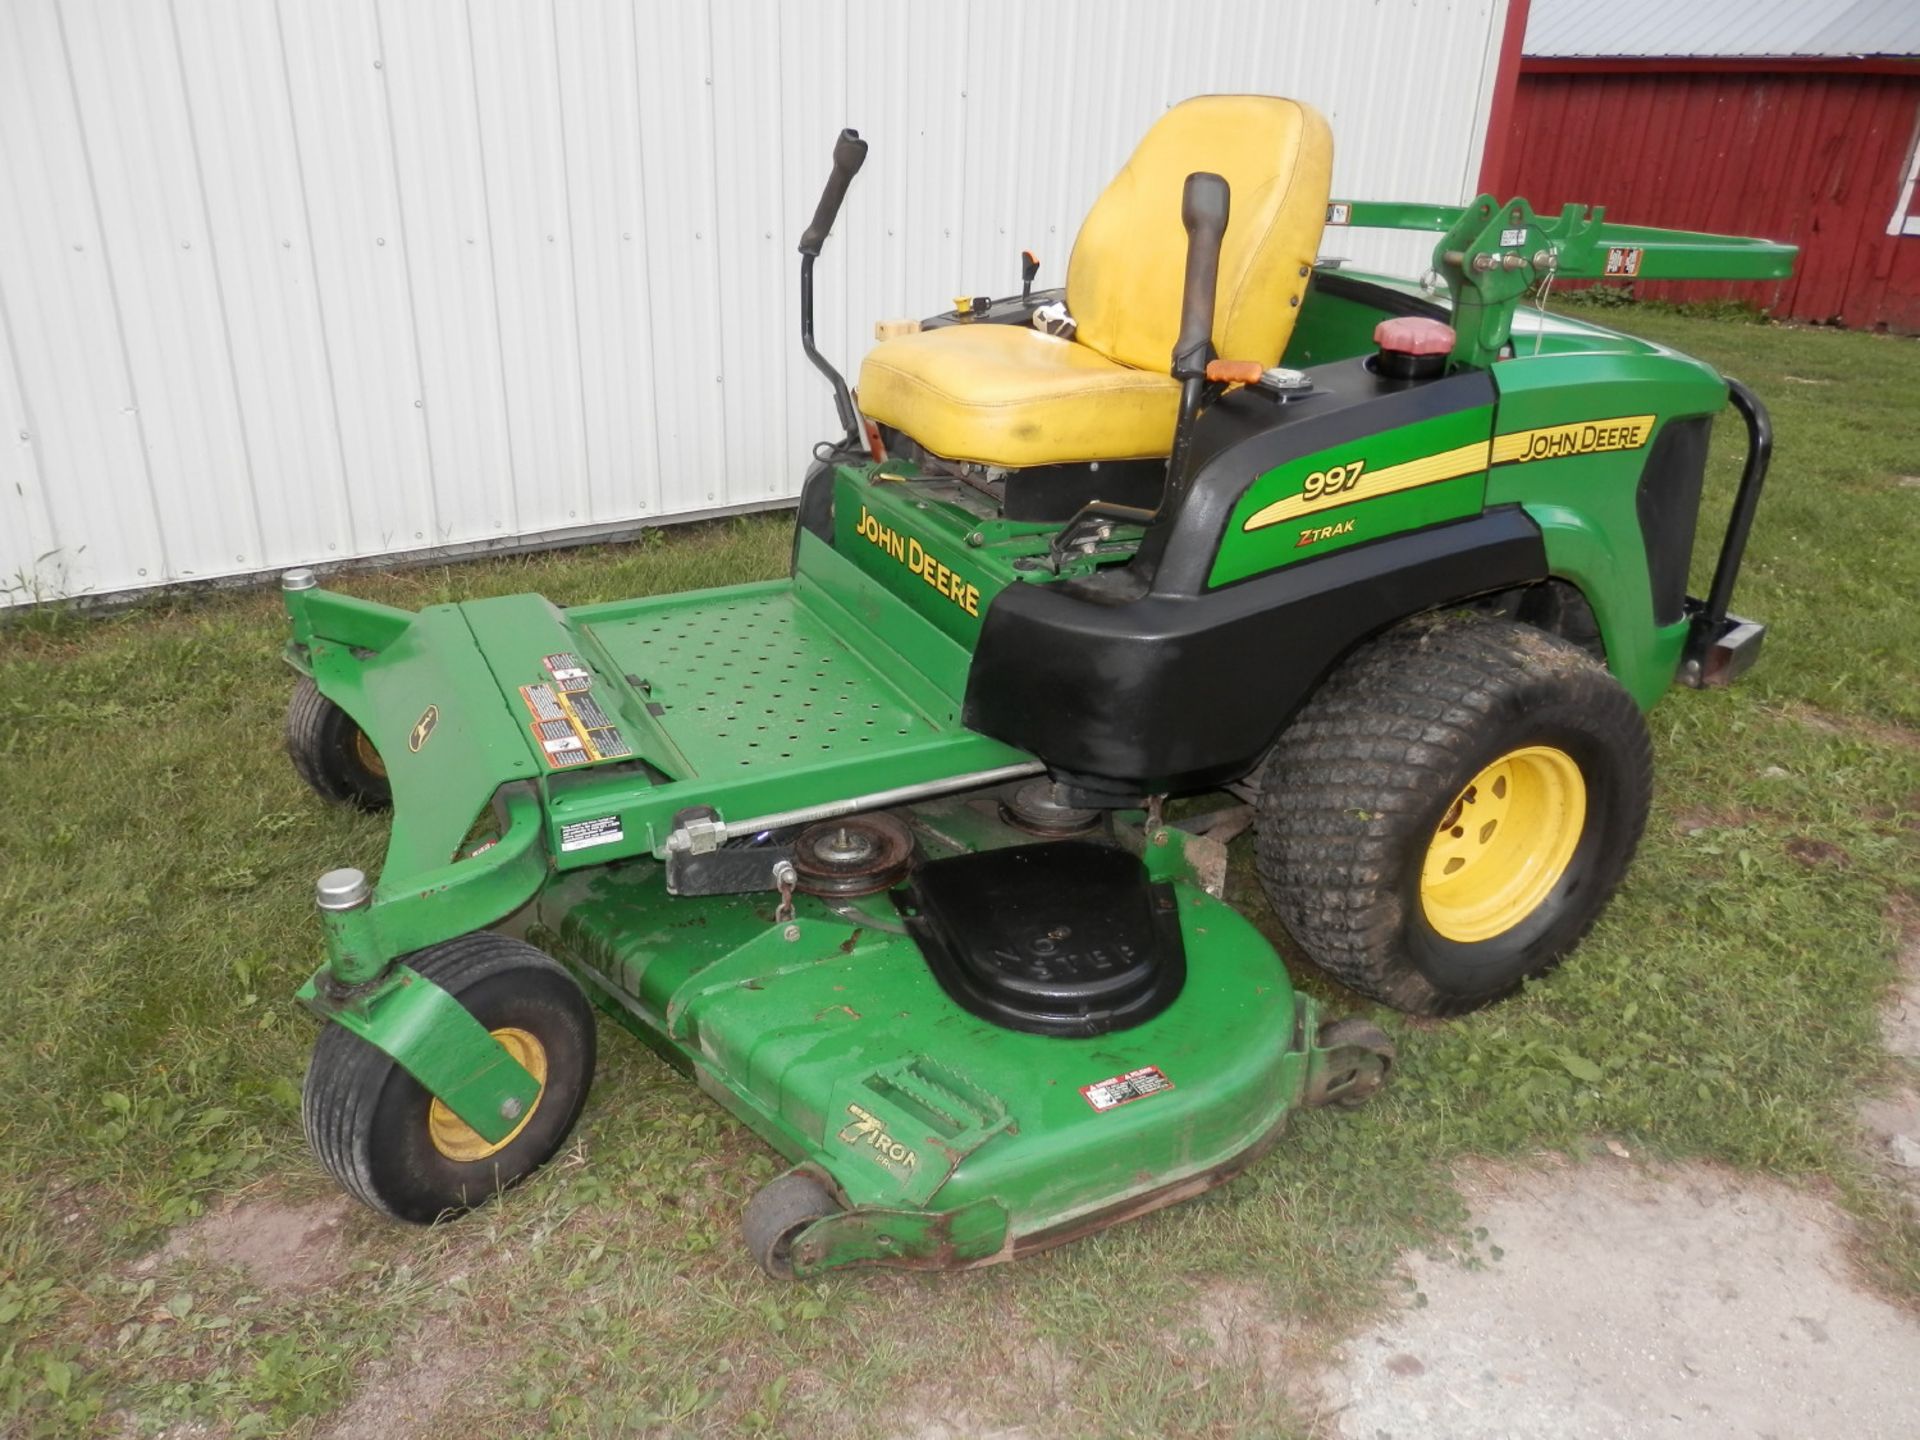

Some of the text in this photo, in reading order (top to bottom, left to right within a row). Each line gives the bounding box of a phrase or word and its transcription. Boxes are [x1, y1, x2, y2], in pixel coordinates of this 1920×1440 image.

[1521, 425, 1642, 461] JOHN DEERE
[1303, 459, 1366, 501] 997
[1296, 519, 1357, 547] ZTRAK
[856, 505, 980, 618] JOHN DEERE
